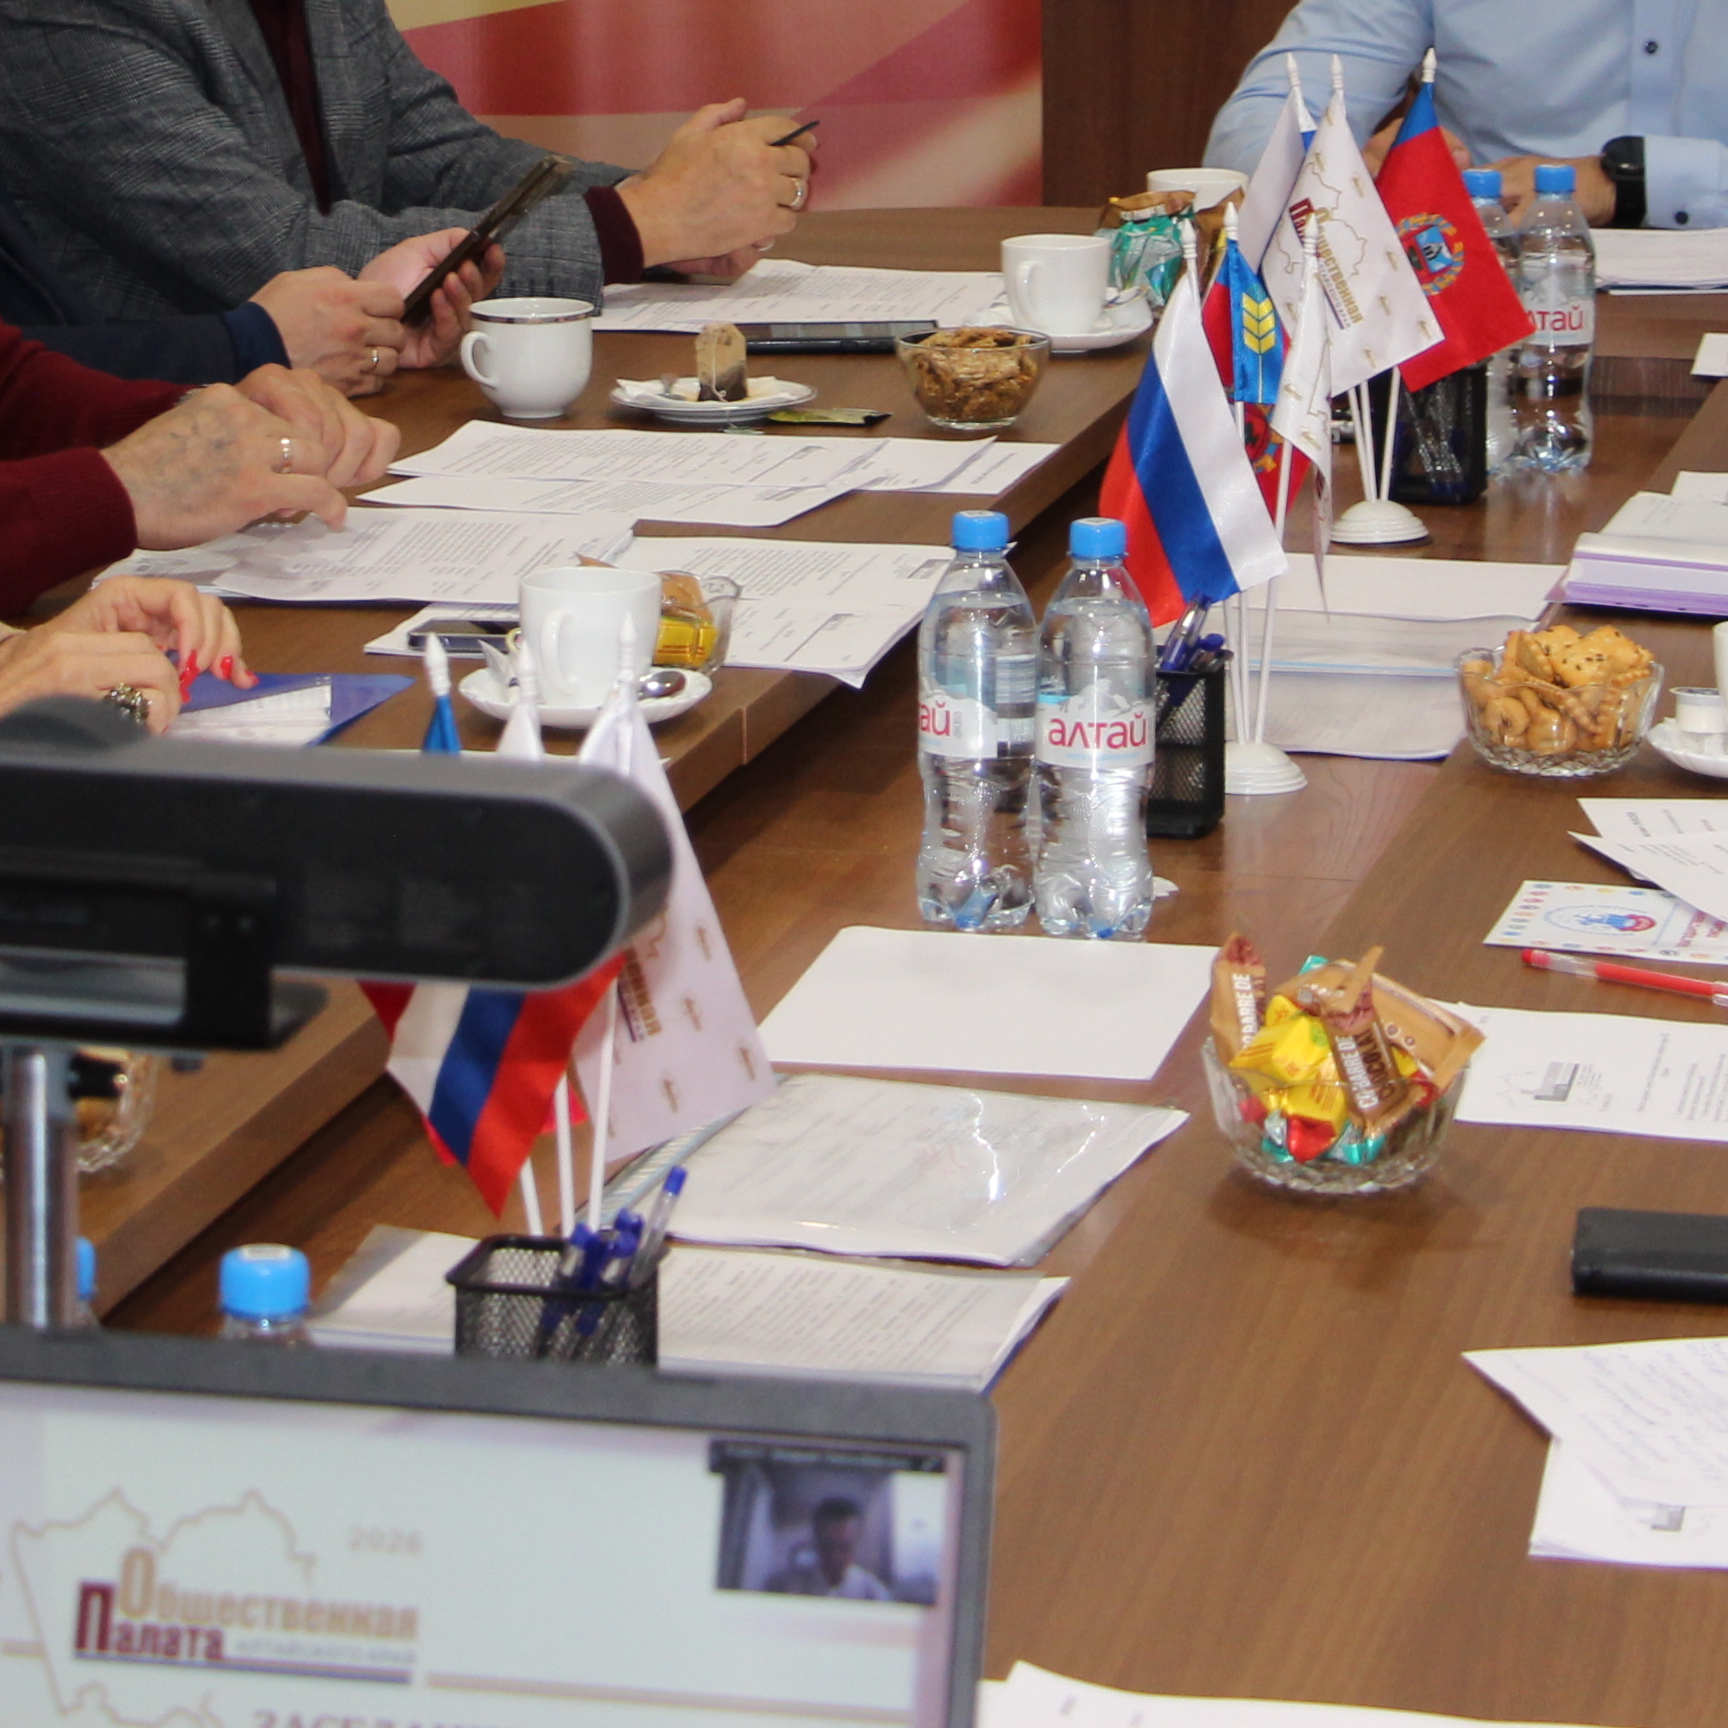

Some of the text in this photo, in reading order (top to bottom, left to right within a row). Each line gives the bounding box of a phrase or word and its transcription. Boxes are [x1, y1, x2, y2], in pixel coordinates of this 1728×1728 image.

[1048, 710, 1148, 750] алтай
[76, 1580, 224, 1661] Палата
[119, 1547, 419, 1641] Общественная
